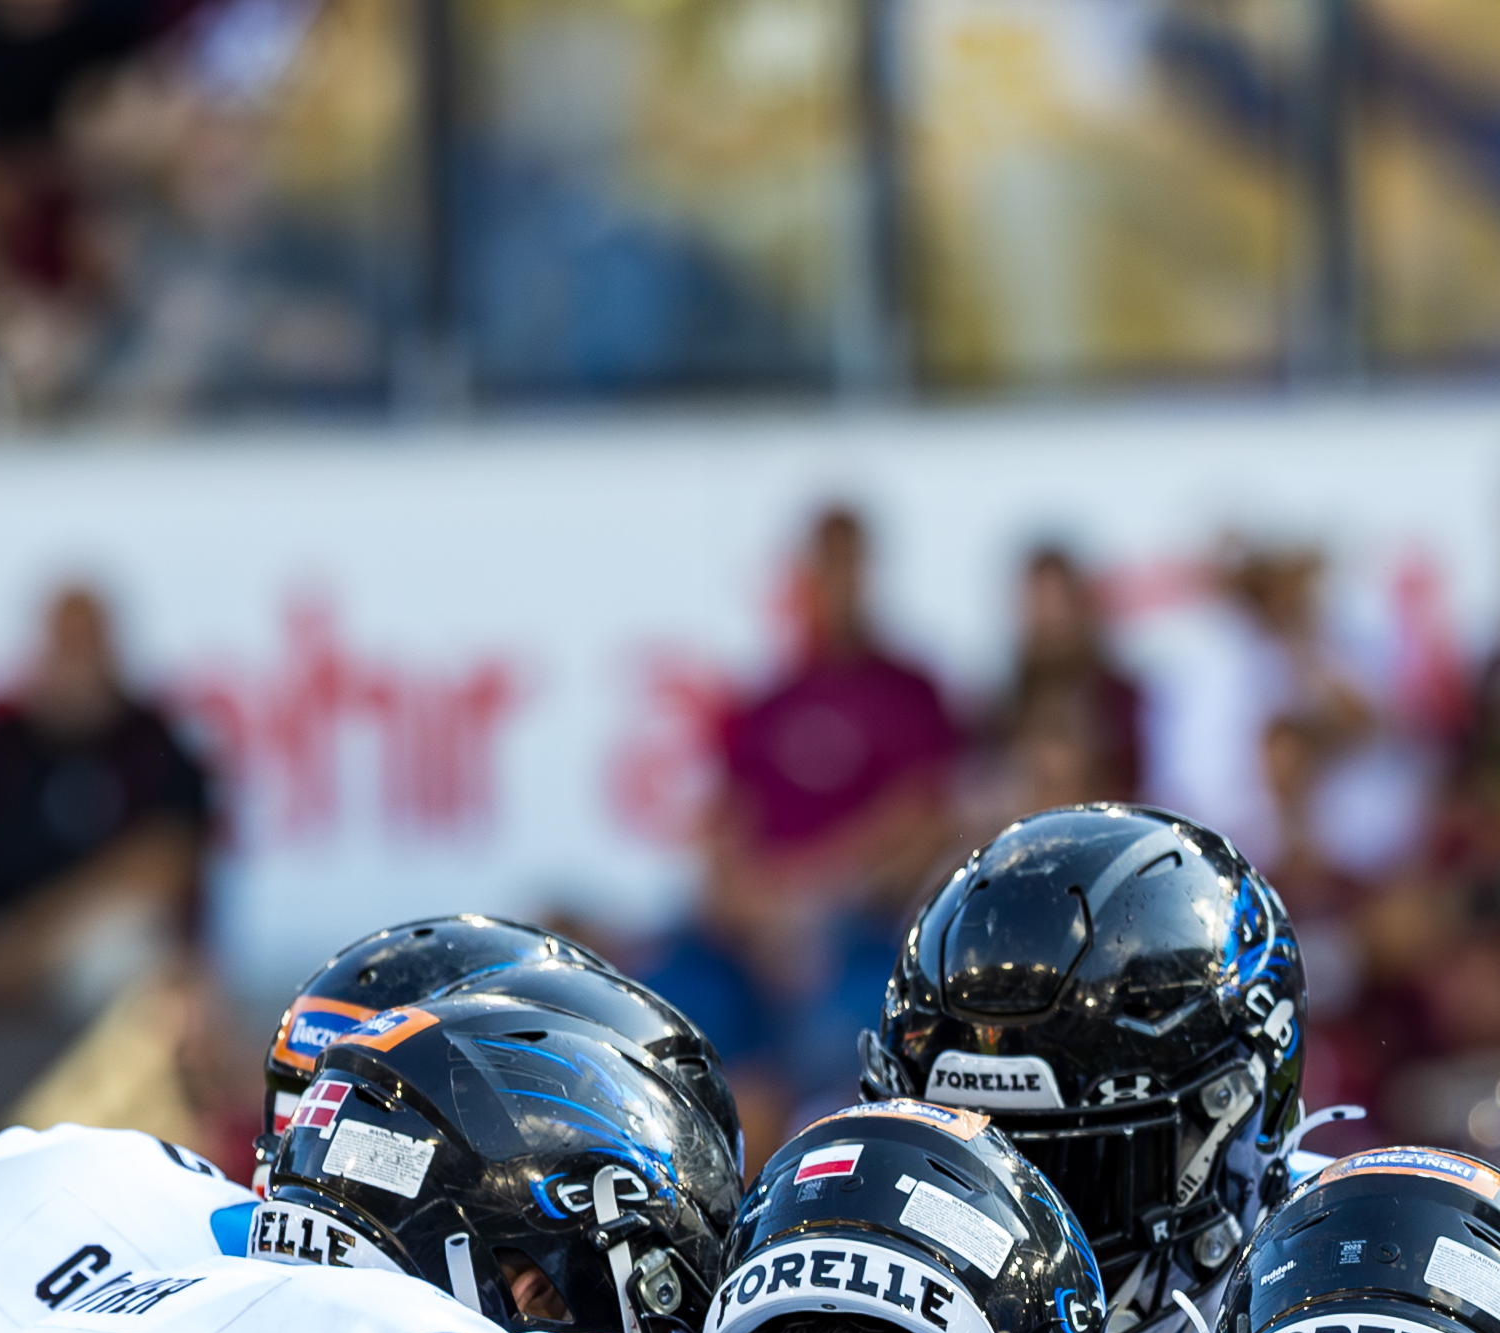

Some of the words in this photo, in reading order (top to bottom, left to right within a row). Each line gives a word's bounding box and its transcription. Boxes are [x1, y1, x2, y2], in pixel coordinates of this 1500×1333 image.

[935, 1070, 1041, 1092] FORELLE
[252, 1211, 356, 1267] ELLE
[716, 1249, 955, 1332] FORELLE
[1260, 1259, 1297, 1286] Riddell
